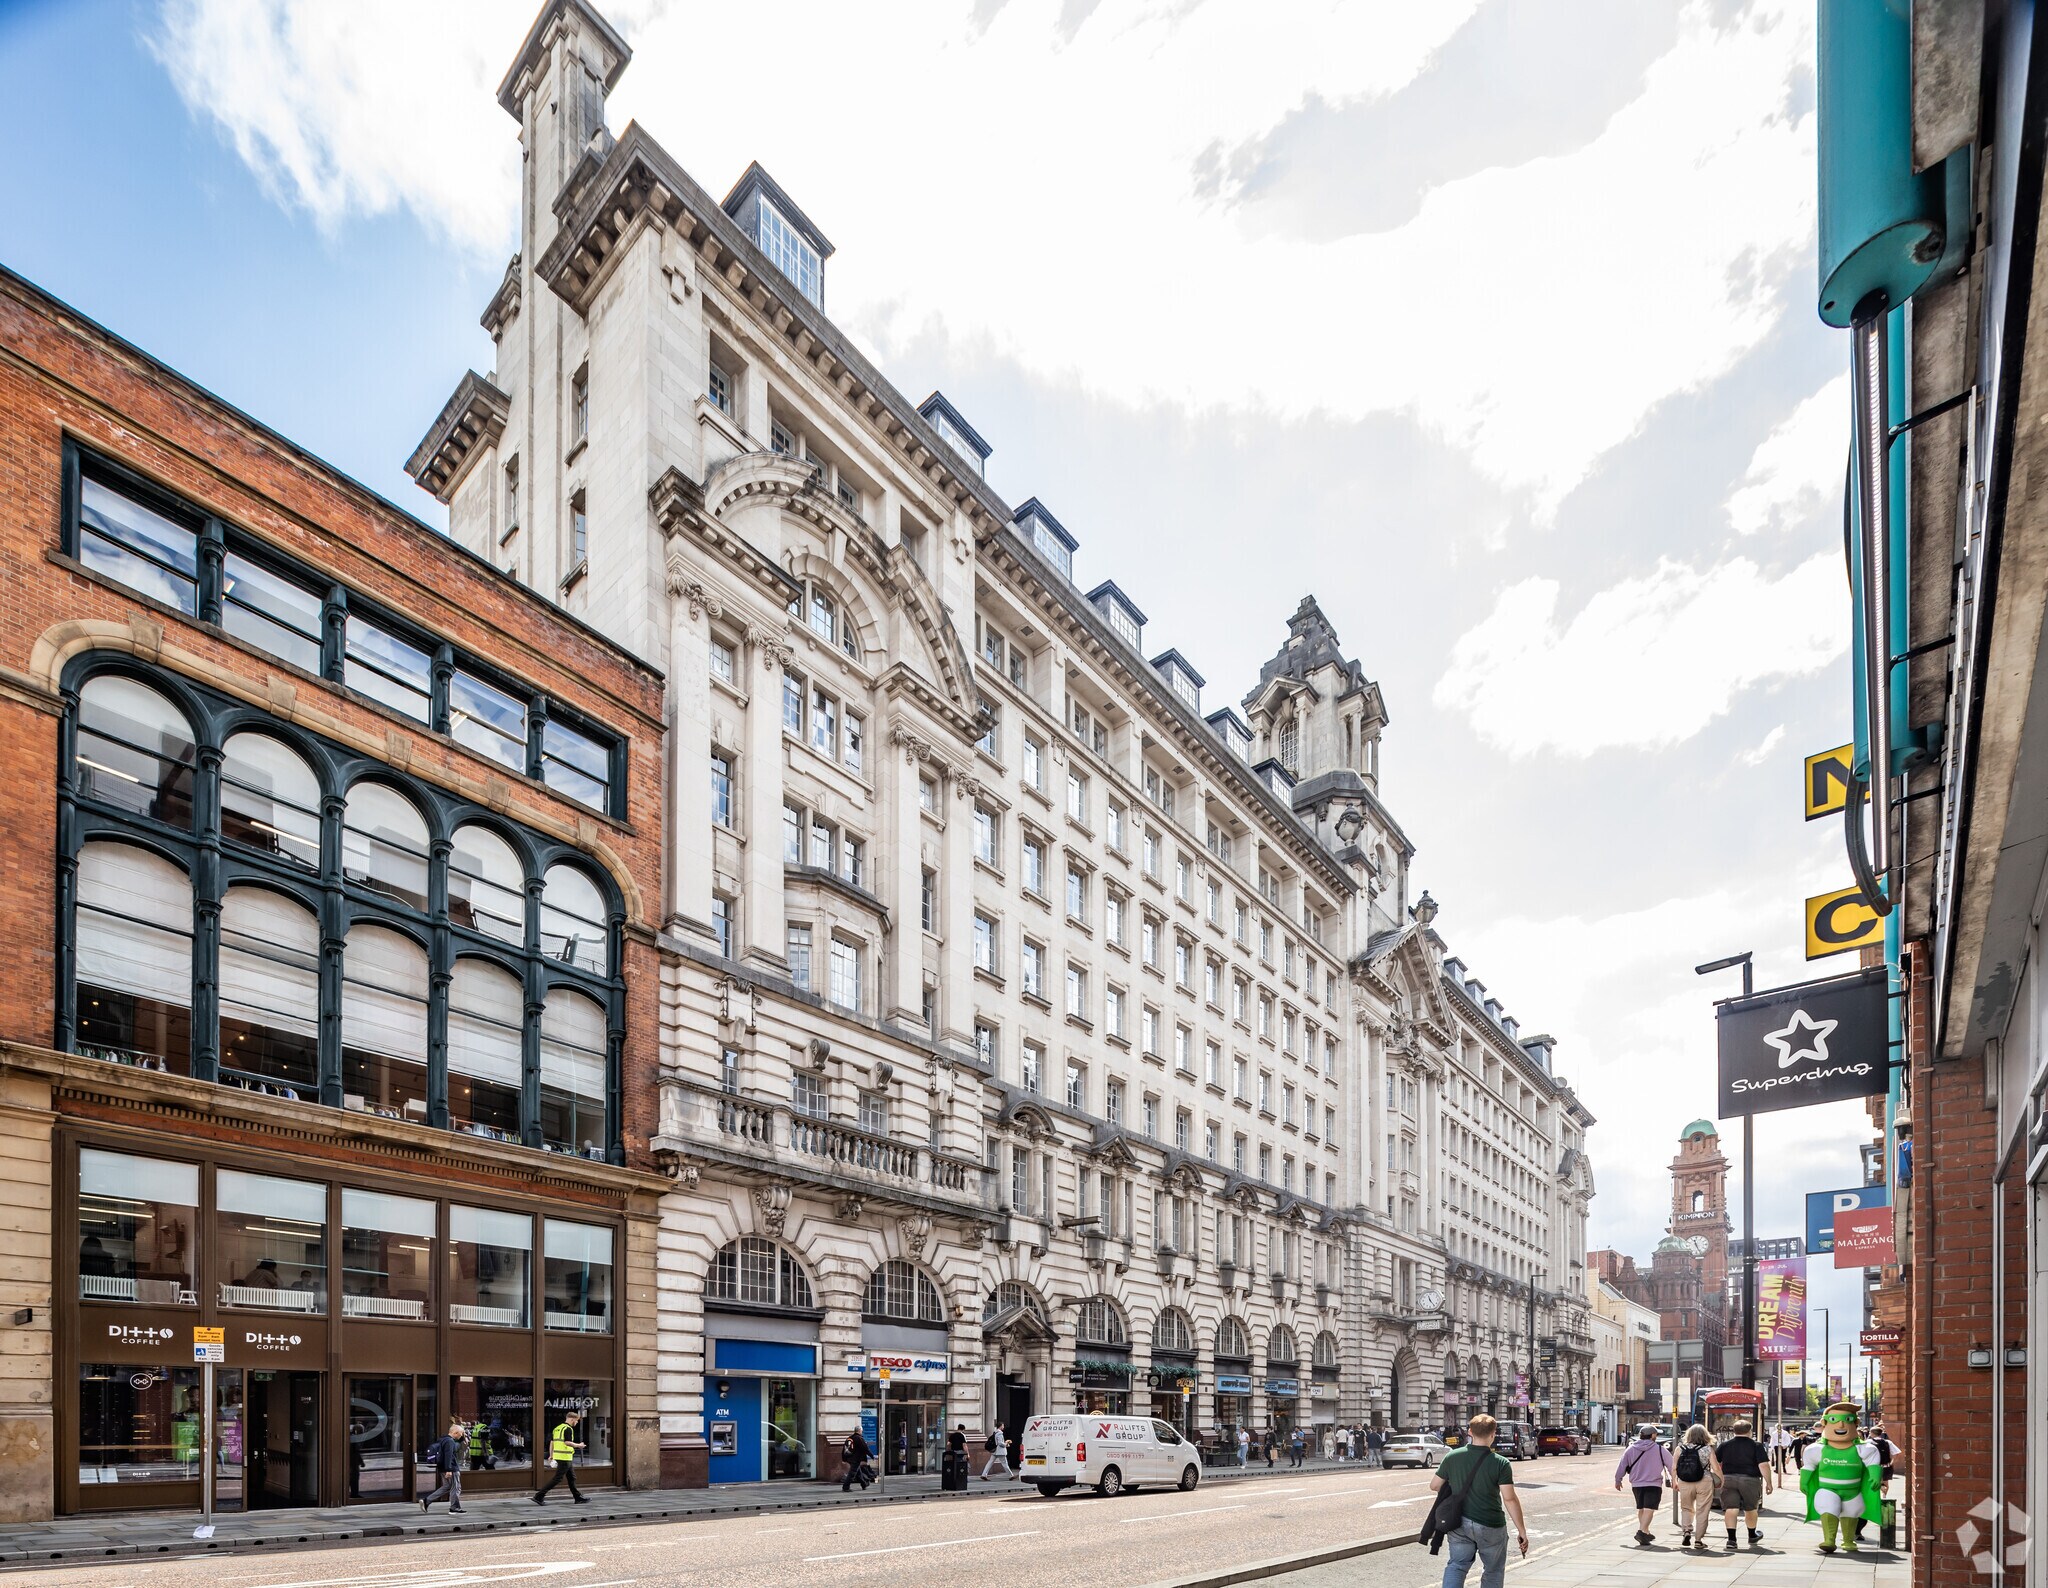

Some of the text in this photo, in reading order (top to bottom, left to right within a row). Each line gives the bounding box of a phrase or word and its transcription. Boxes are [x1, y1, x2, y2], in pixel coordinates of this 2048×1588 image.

[1814, 892, 1878, 943] C
[1732, 1063, 1872, 1093] Superdrug
[1678, 1211, 1715, 1221] KIMPTON
[1837, 1236, 1894, 1247] MALATANG
[1758, 1274, 1784, 1340] DREAM
[1775, 1275, 1806, 1340] Differently
[121, 1338, 160, 1346] COFFEE
[870, 1357, 948, 1371] TESCO express
[1116, 1432, 1144, 1440] GROUP
